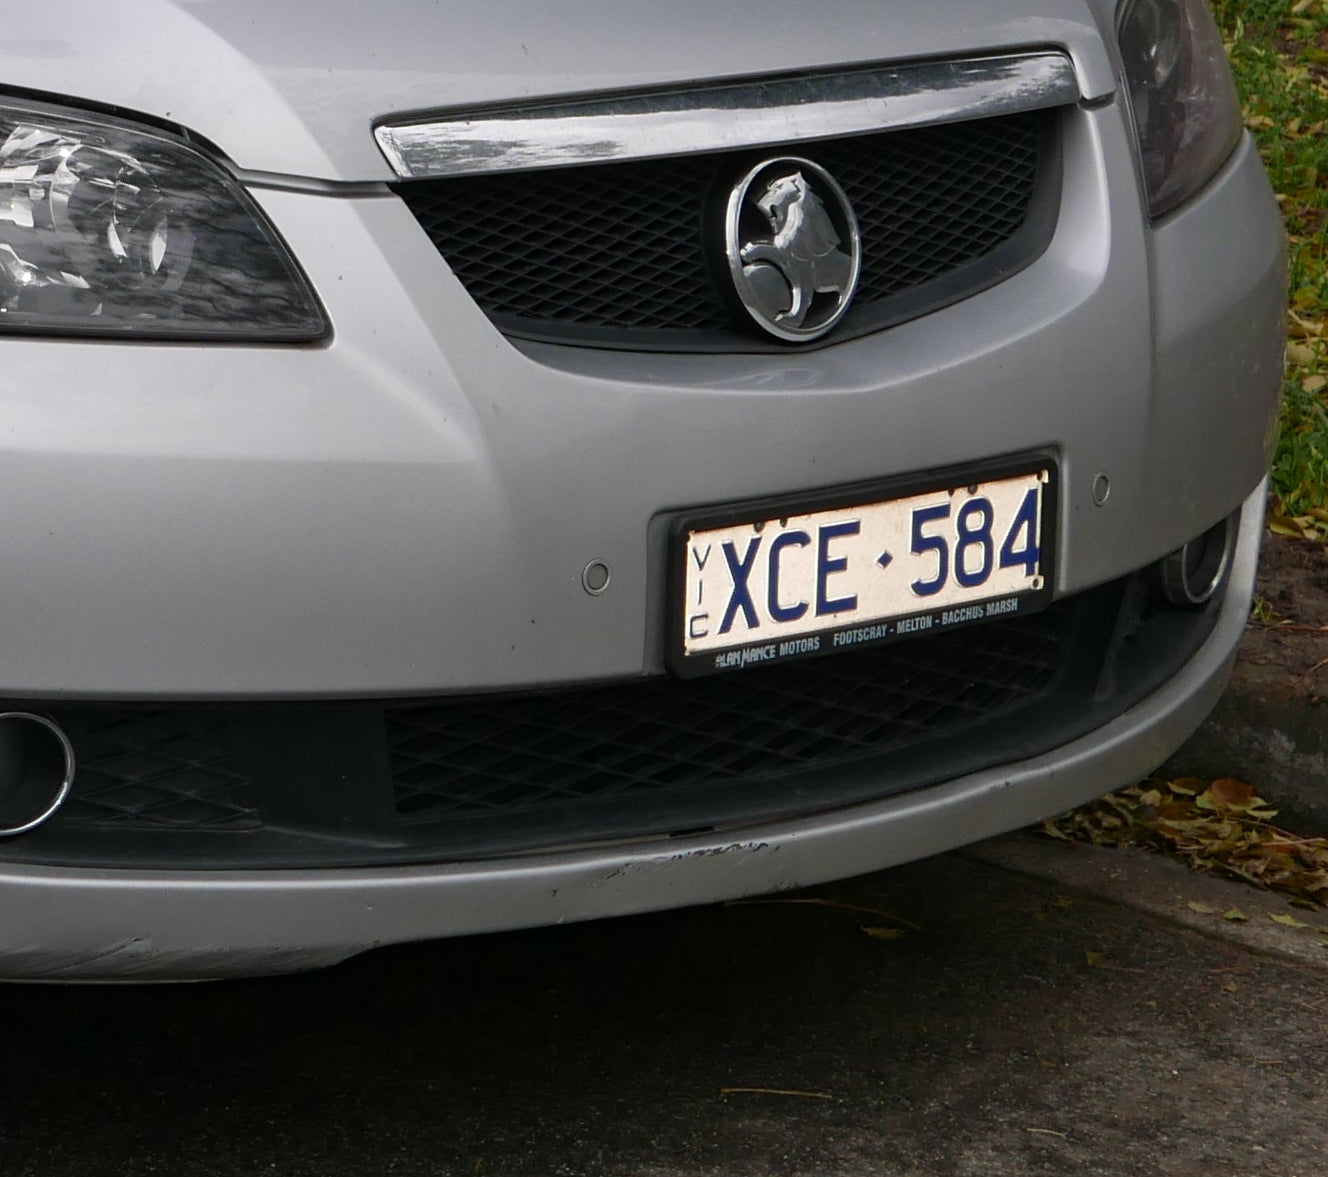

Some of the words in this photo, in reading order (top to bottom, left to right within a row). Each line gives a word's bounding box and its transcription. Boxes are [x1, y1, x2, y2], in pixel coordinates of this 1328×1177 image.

[910, 487, 1040, 598] 584
[779, 636, 821, 656] MOTORS
[833, 624, 888, 647] FOOTSCRAY
[896, 615, 933, 635] MELTON
[941, 605, 984, 625] BACCHUS
[986, 597, 1019, 617] MARSH
